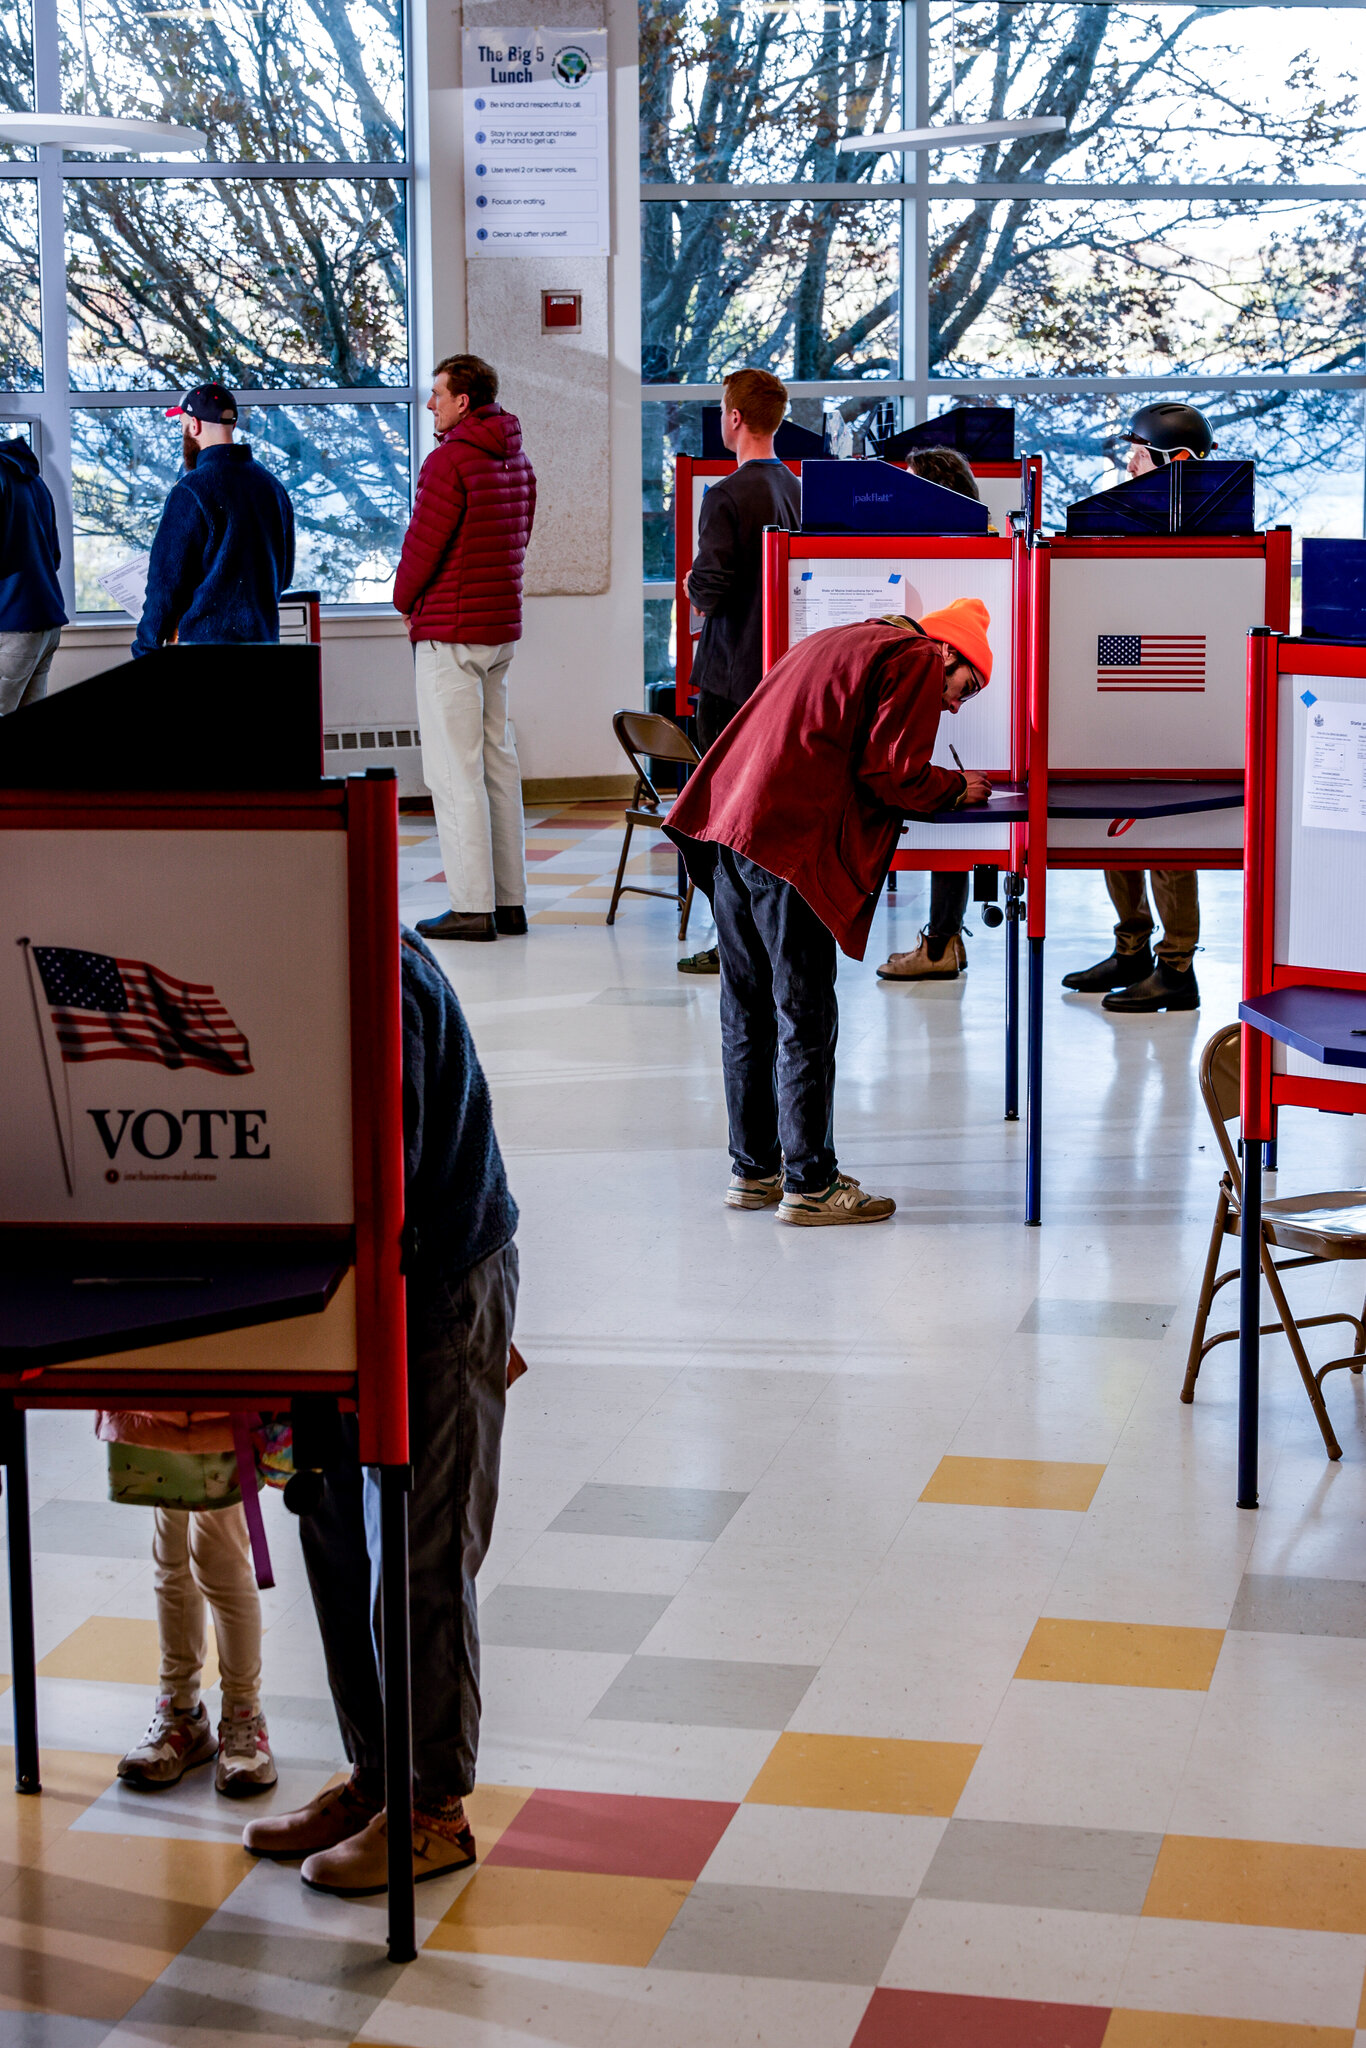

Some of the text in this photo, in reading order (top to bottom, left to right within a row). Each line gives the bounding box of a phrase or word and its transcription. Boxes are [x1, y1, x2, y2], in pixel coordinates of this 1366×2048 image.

[478, 46, 503, 62] The
[508, 46, 532, 66] Big
[536, 46, 544, 62] 5
[491, 67, 532, 83] Lunch
[530, 102, 564, 110] respectful
[86, 1109, 270, 1160] VOTE
[834, 1192, 857, 1210] N
